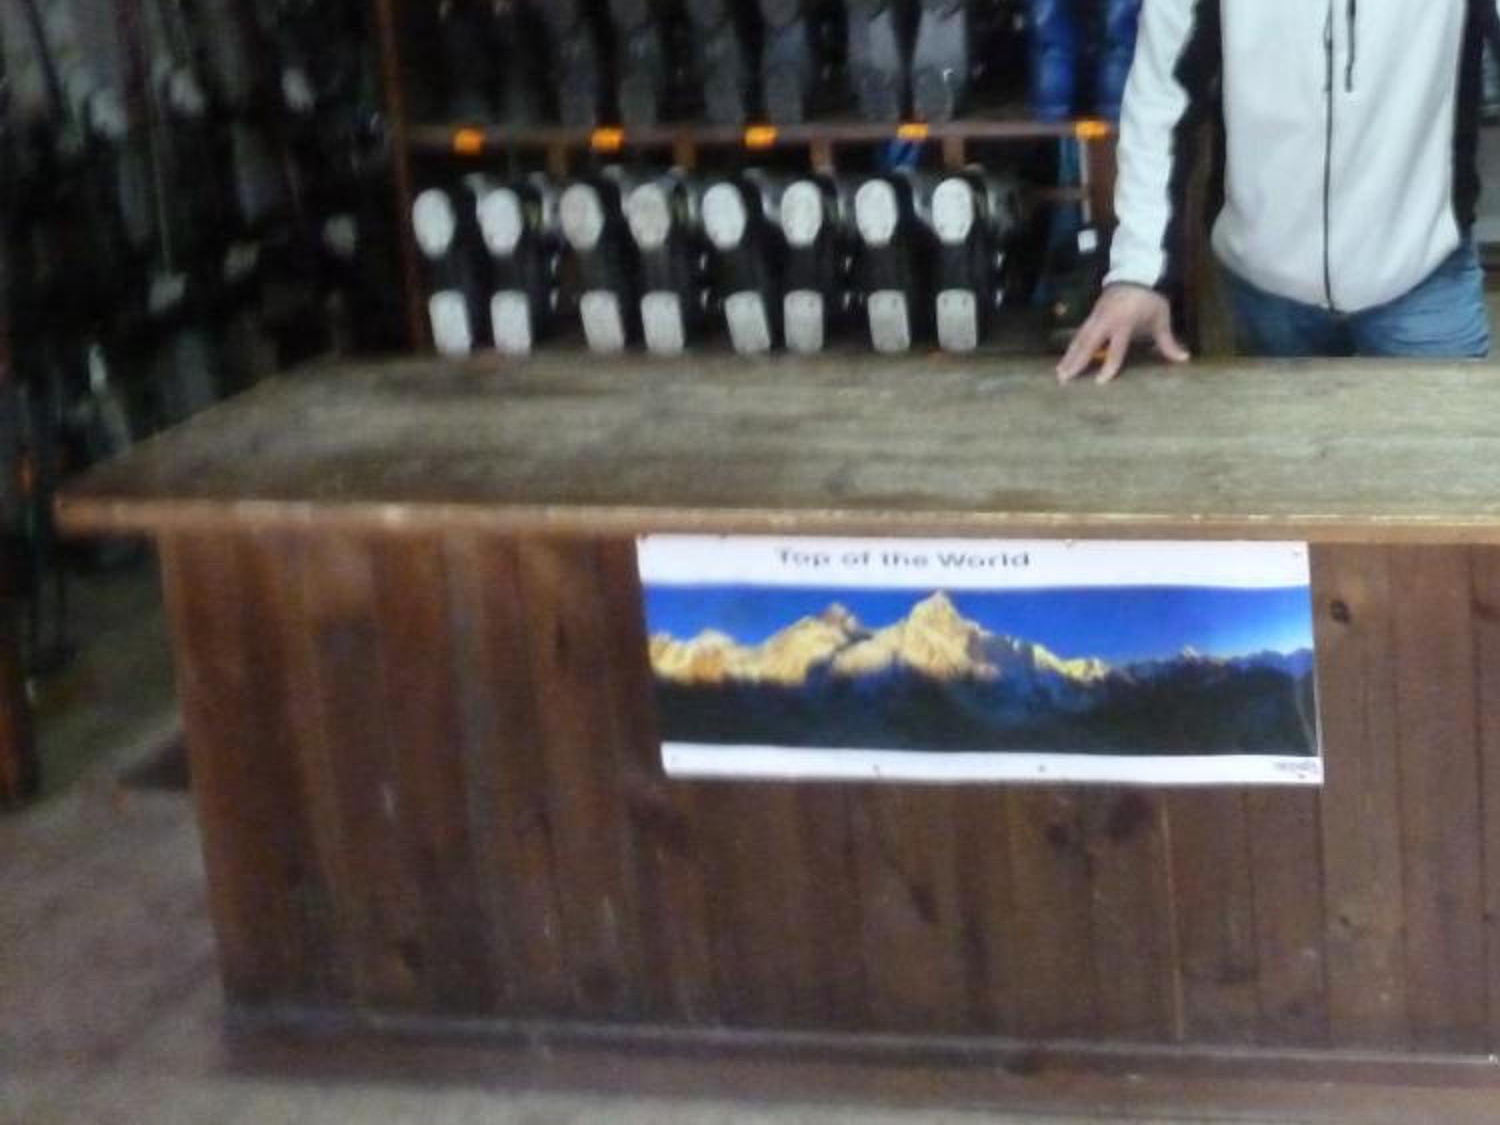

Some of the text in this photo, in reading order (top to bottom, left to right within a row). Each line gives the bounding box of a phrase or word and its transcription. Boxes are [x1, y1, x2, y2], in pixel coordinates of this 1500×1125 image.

[777, 548, 1031, 568] Top of the World
